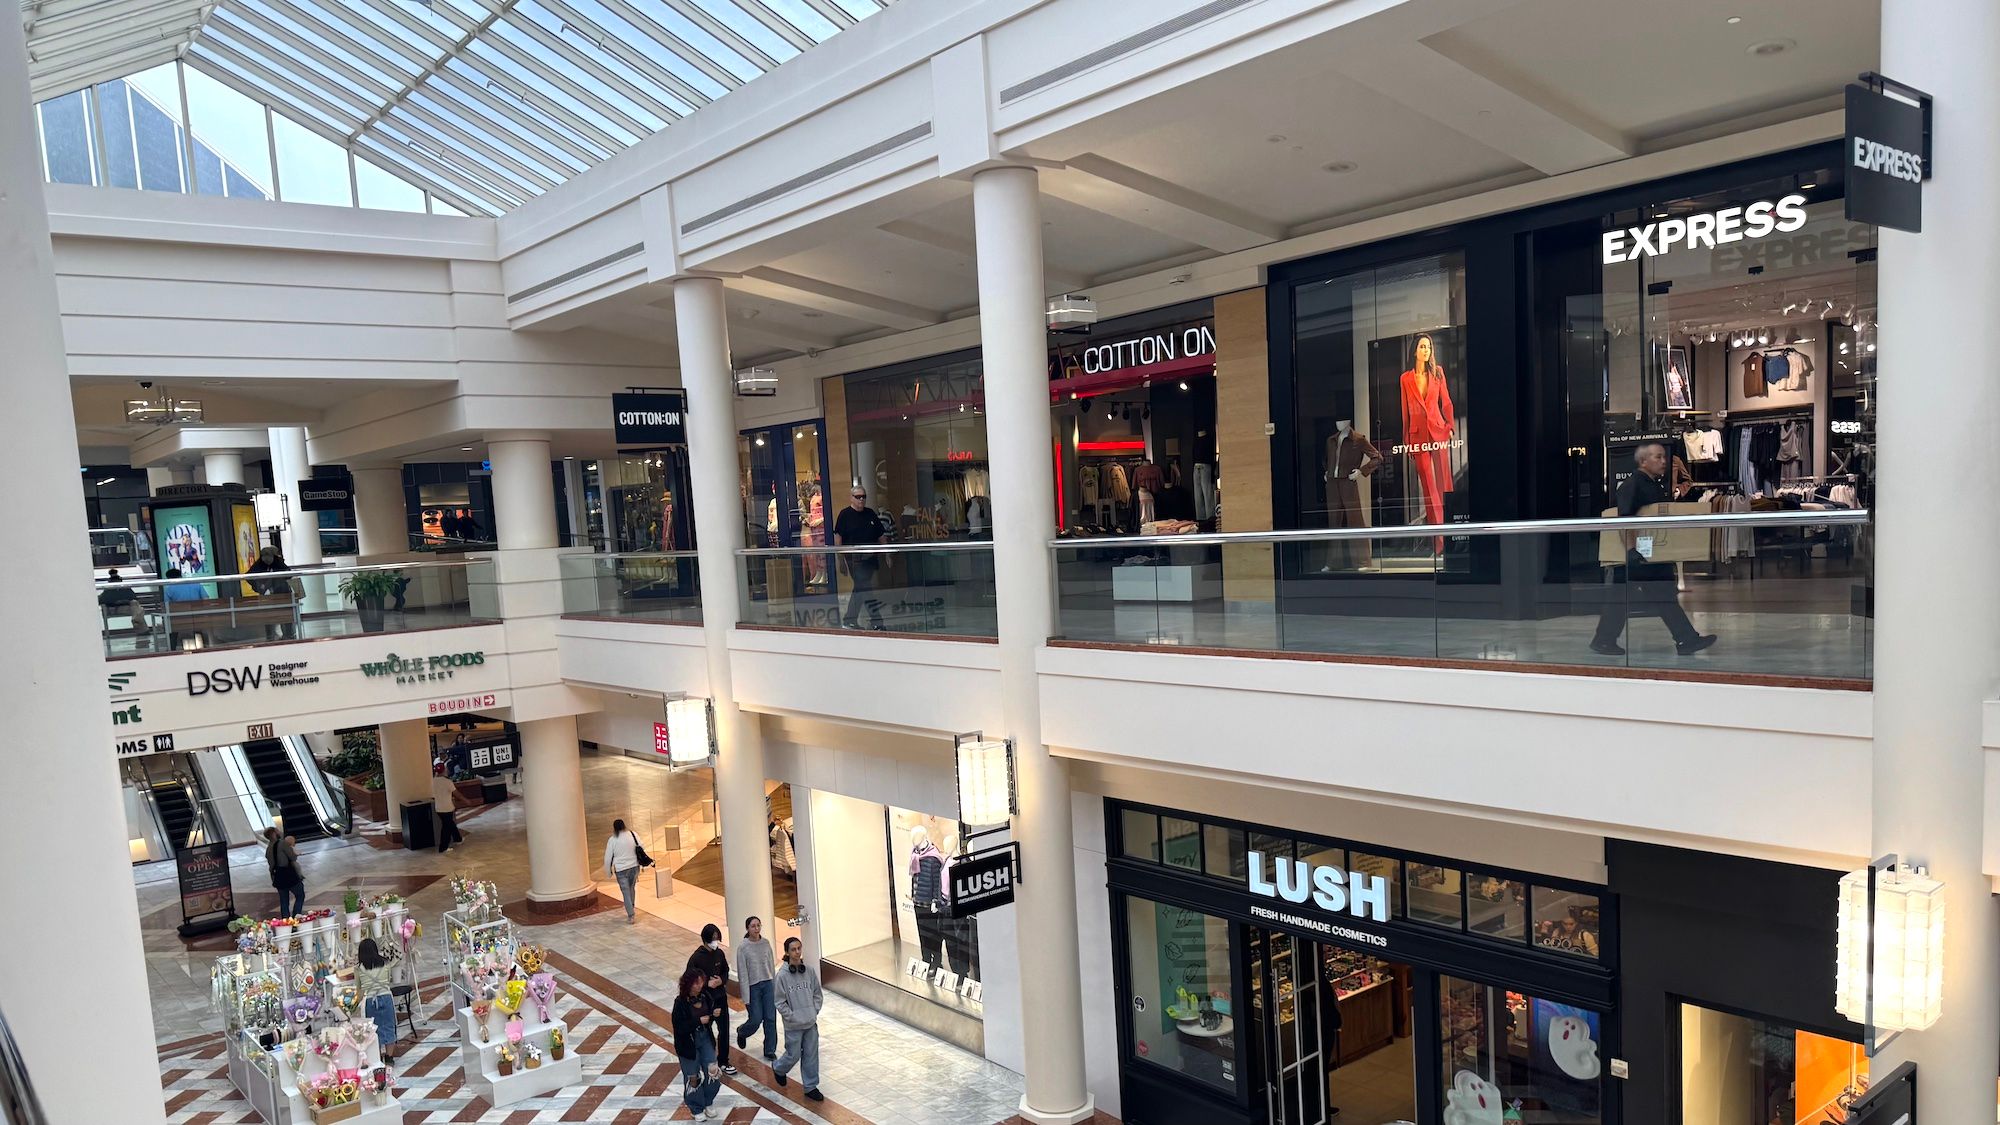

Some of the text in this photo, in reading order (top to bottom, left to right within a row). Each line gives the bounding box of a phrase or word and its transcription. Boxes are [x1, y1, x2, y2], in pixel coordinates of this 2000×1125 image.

[1853, 136, 1922, 184] EXPRESS
[1602, 194, 1807, 265] EXPRESS
[1084, 325, 1217, 374] COTTON ON
[619, 411, 680, 426] COTTON:ON
[1621, 434, 1629, 442] OF
[1642, 432, 1669, 440] ARRIVALS
[1392, 439, 1464, 455] STYLE GLOW-UP
[1615, 472, 1633, 480] BUY
[158, 485, 208, 496] DIRECTORY
[303, 489, 347, 501] GameStop
[909, 523, 950, 540] THINGS
[268, 660, 308, 671] Designer
[360, 651, 485, 678] WHOLE FOODS
[187, 664, 263, 696] DSW
[269, 671, 293, 680] Shoe
[270, 675, 320, 688] Warehouse
[396, 670, 454, 685] MARKET
[429, 696, 482, 713] BOUDIN
[112, 704, 142, 725] nt
[248, 724, 272, 738] EXIT
[495, 746, 509, 755] UNI
[496, 754, 511, 763] QLO
[188, 861, 219, 873] OPEN
[957, 867, 1009, 898] LUSH
[1248, 850, 1390, 923] LUSH
[1251, 905, 1388, 948] FRESH HANDMADE COSMETICS
